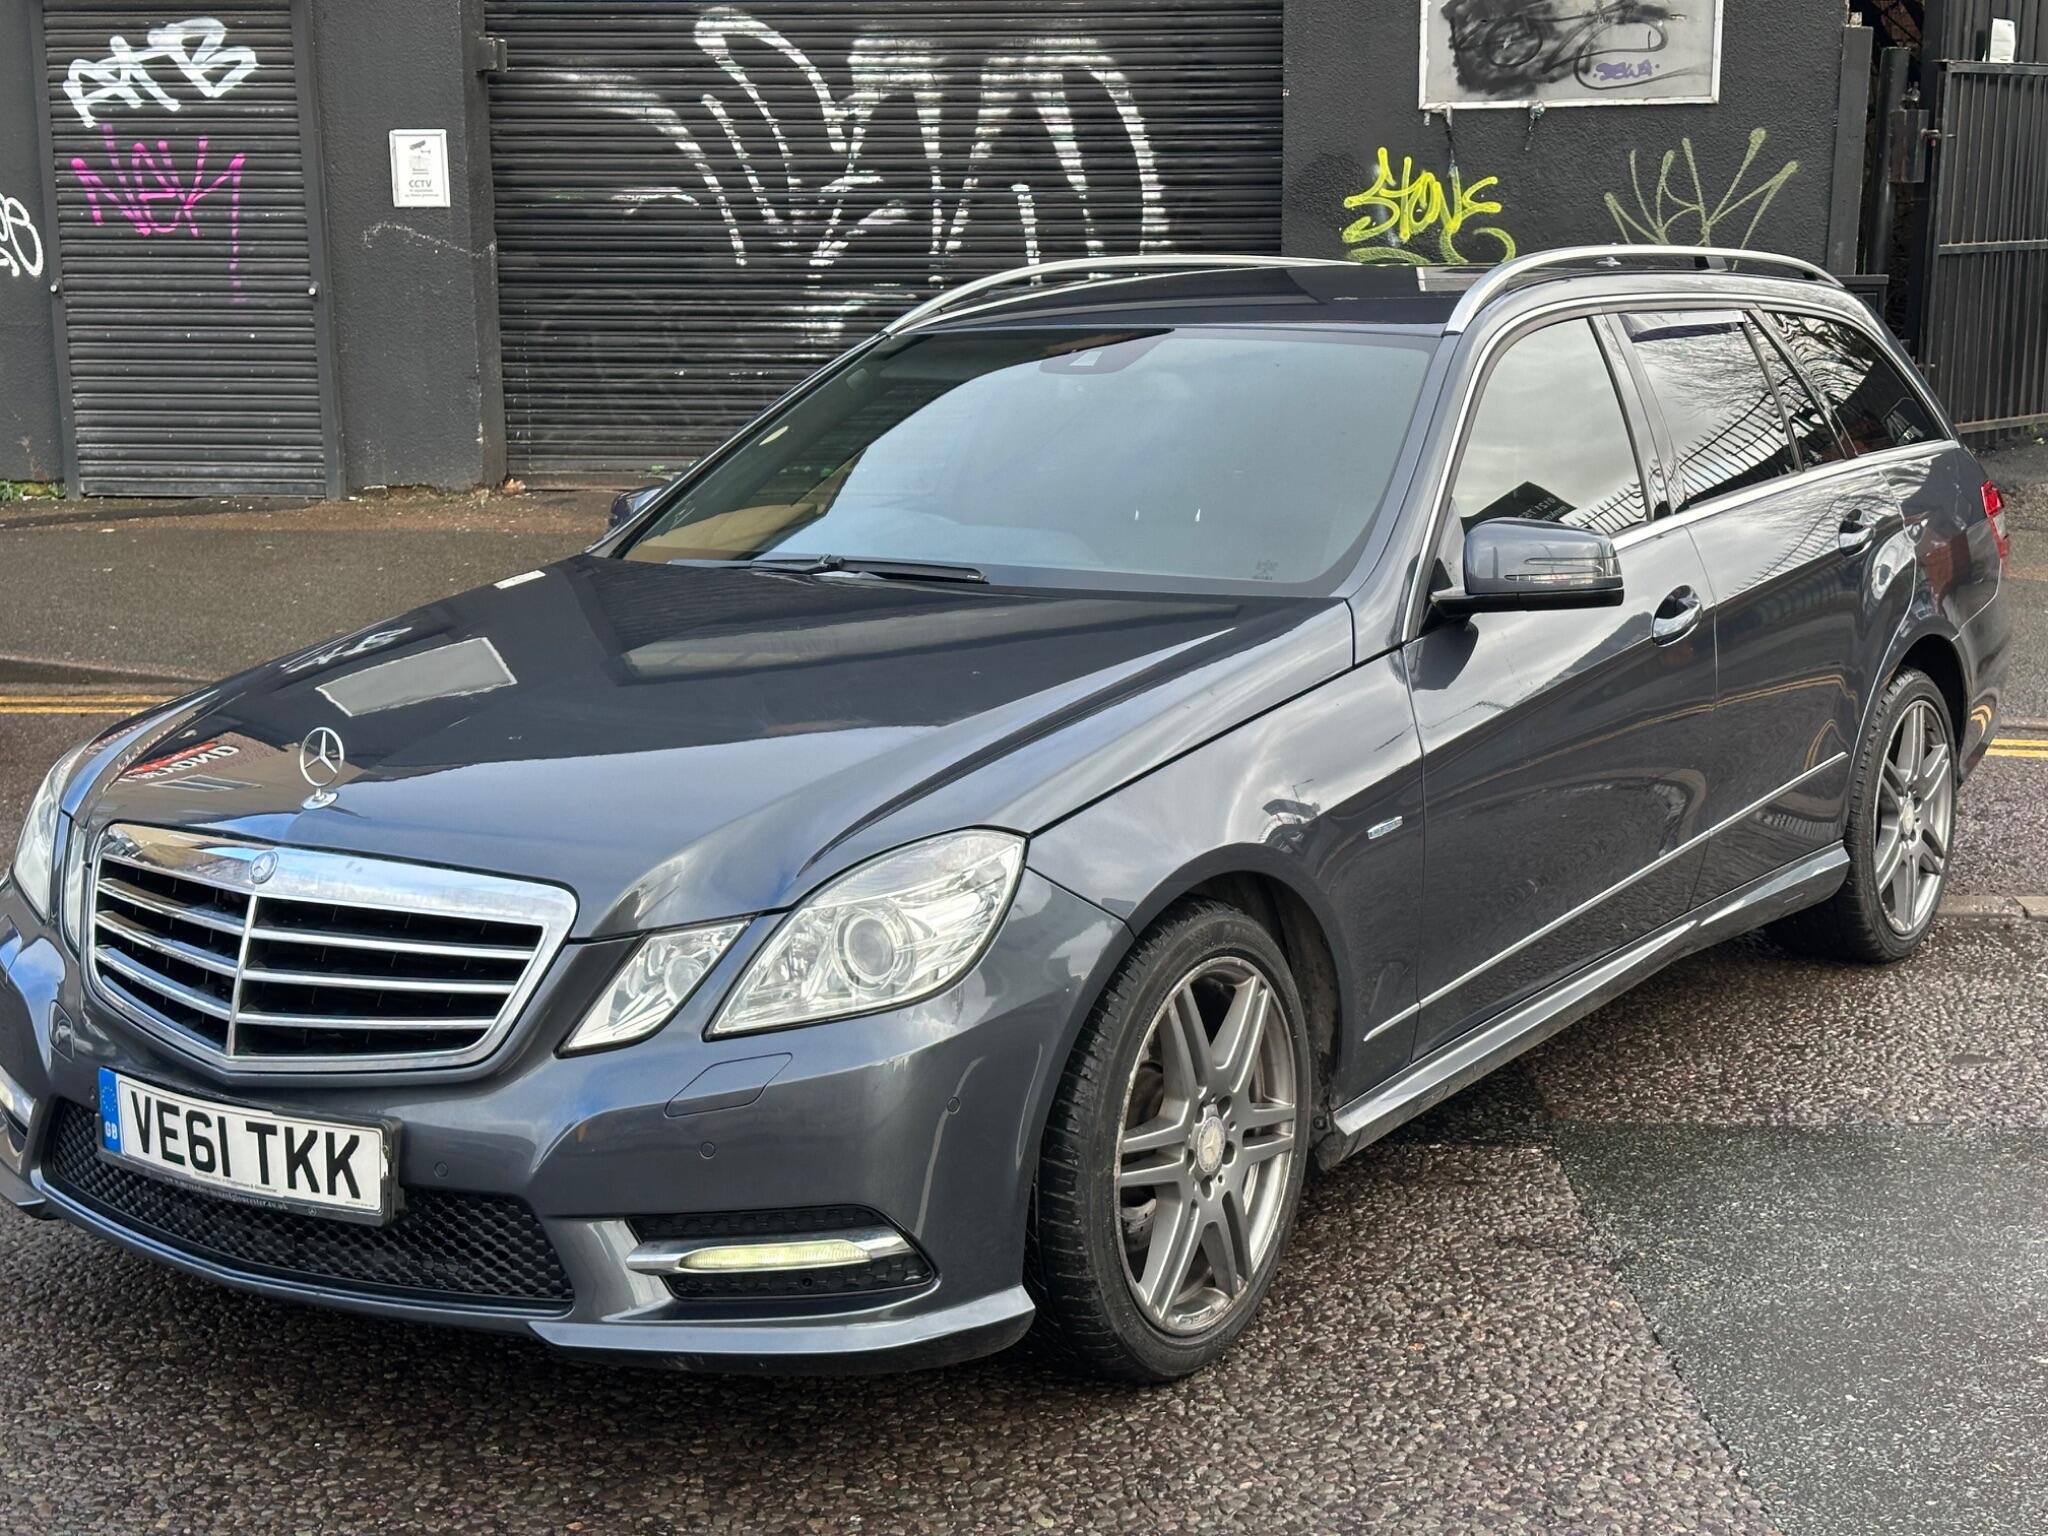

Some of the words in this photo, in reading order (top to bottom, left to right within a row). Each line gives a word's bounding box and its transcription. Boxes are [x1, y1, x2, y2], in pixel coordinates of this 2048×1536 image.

[408, 179, 432, 189] CCTV
[104, 1120, 118, 1140] GB
[131, 1090, 231, 1177] VE61
[246, 1120, 361, 1200] TKK
